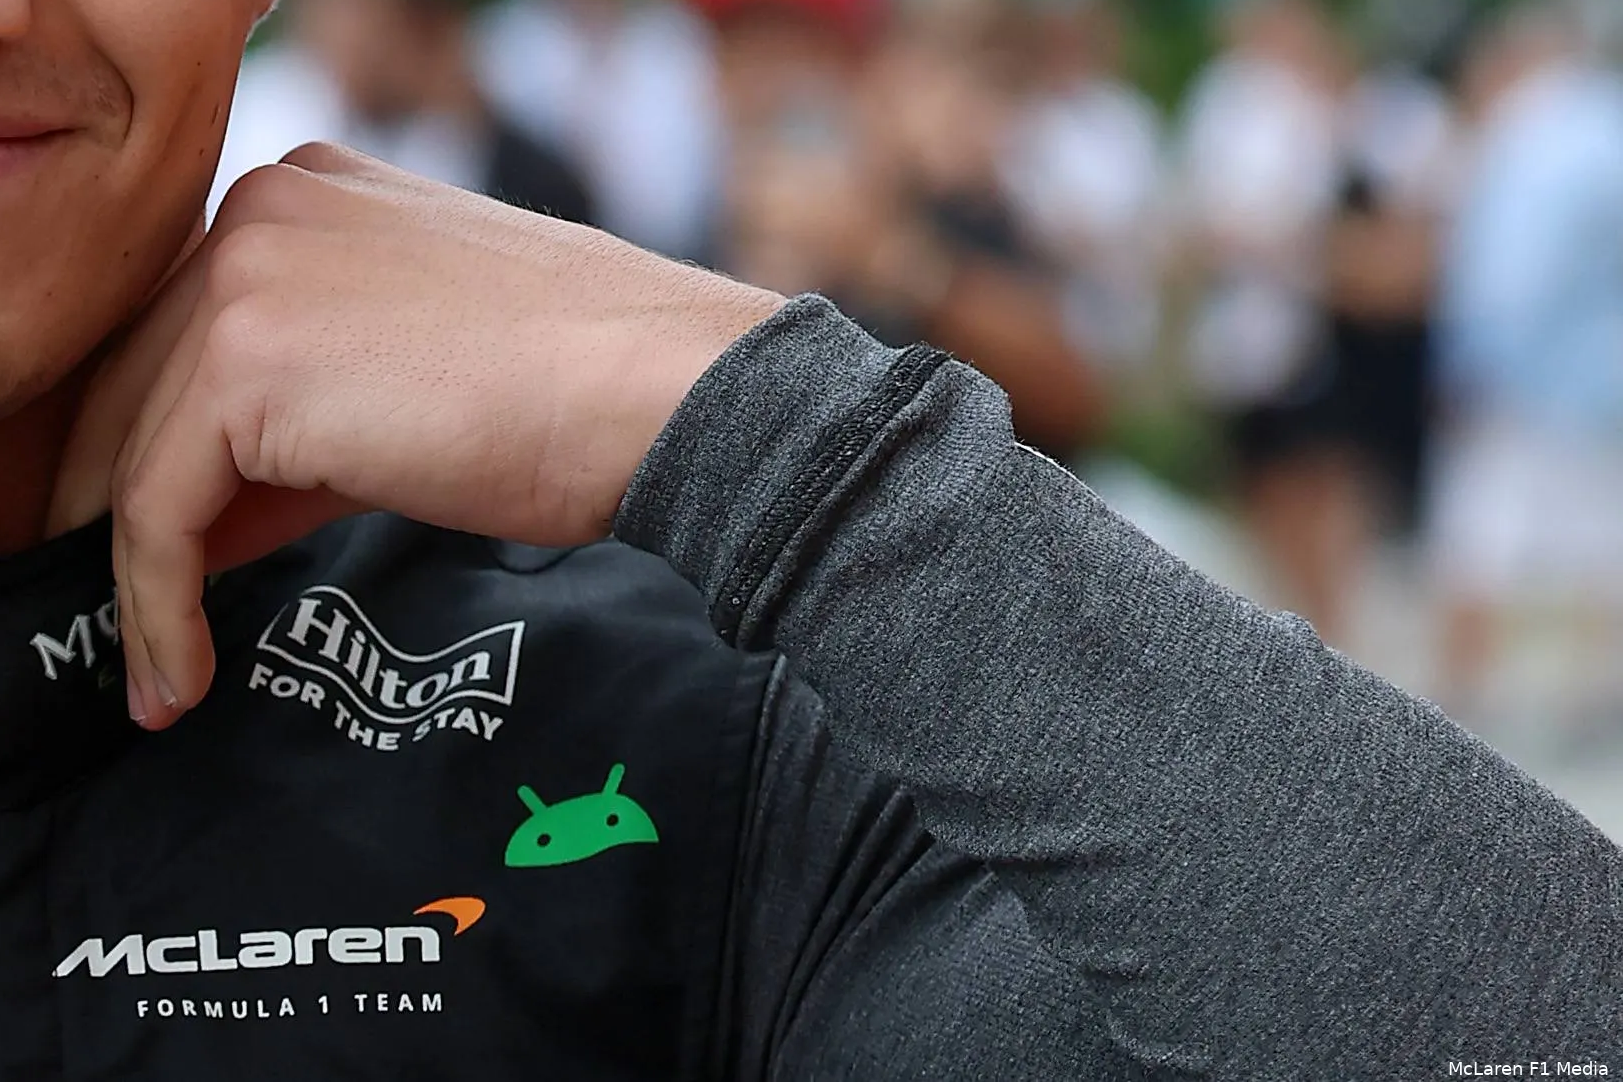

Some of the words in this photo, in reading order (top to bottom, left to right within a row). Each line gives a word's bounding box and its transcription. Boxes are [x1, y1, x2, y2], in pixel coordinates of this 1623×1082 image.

[287, 598, 491, 710] Hilton
[248, 662, 326, 710] FOR
[333, 700, 401, 752] THE
[411, 706, 505, 742] STAY
[52, 926, 441, 978] McLaren
[137, 996, 296, 1019] FORMULA
[318, 995, 329, 1014] 1
[354, 993, 443, 1013] TEAM
